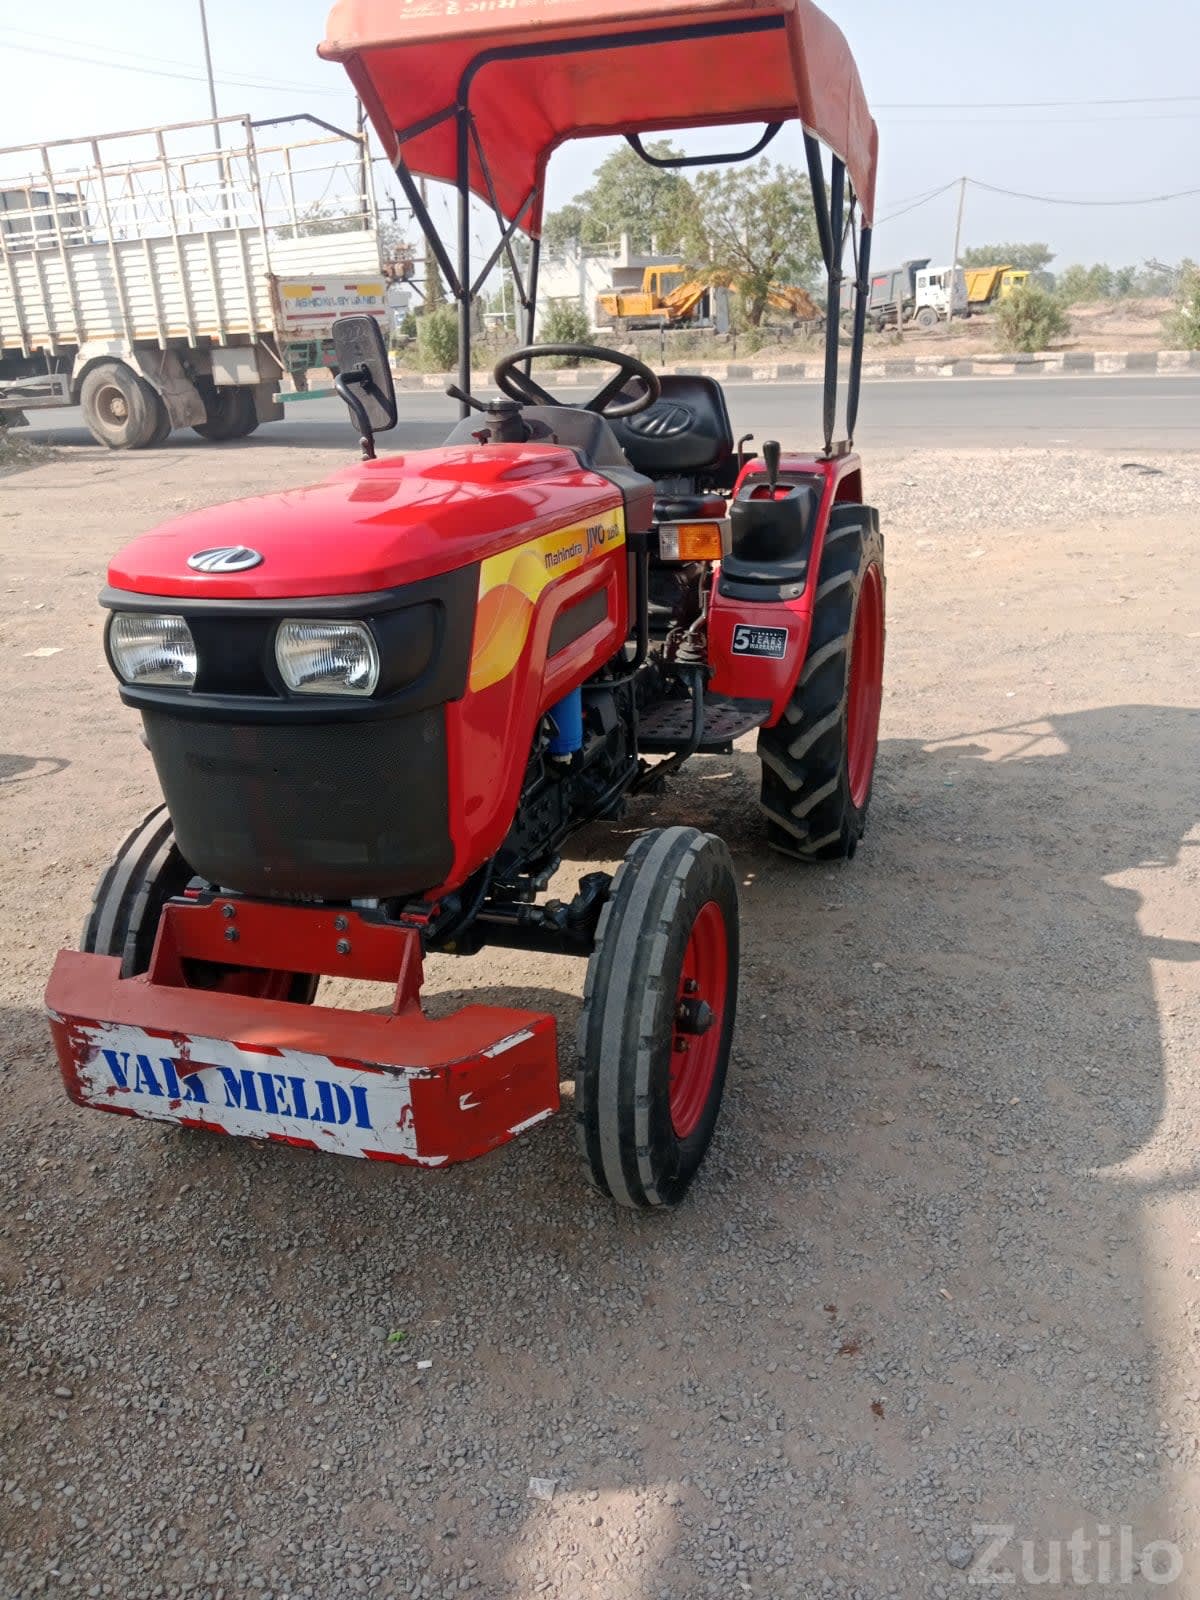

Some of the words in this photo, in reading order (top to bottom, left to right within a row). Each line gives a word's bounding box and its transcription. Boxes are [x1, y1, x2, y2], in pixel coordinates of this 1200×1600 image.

[544, 543, 583, 568] Mahindra
[733, 628, 751, 650] 5
[750, 634, 782, 647] YEARS
[216, 1067, 374, 1130] MELDI
